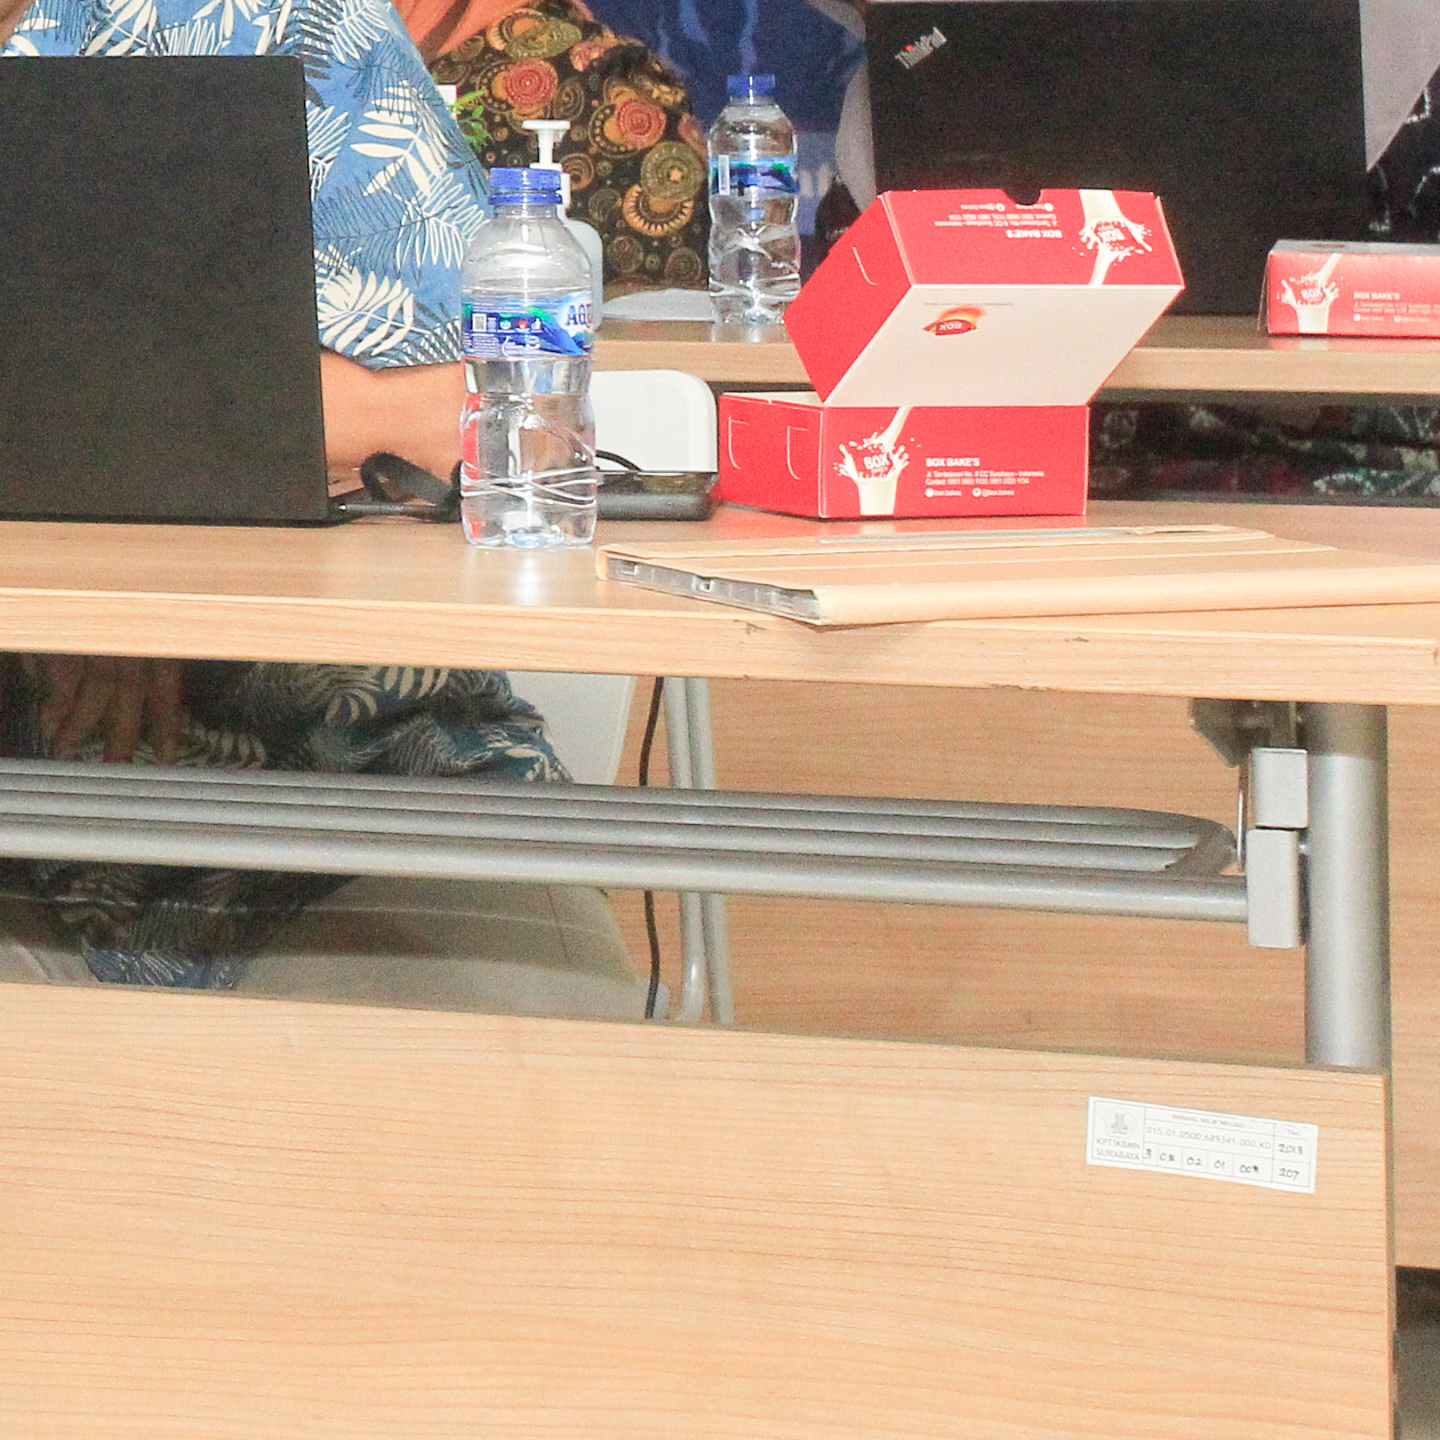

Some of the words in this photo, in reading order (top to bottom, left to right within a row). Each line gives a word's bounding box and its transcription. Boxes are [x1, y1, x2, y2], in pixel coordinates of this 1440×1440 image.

[1040, 229, 1062, 238] BOX
[863, 453, 890, 469] BOX
[925, 458, 945, 467] BOX
[946, 457, 980, 467] BAKE'S
[1278, 1143, 1304, 1155] 2013
[1278, 1168, 1300, 1181] 207
